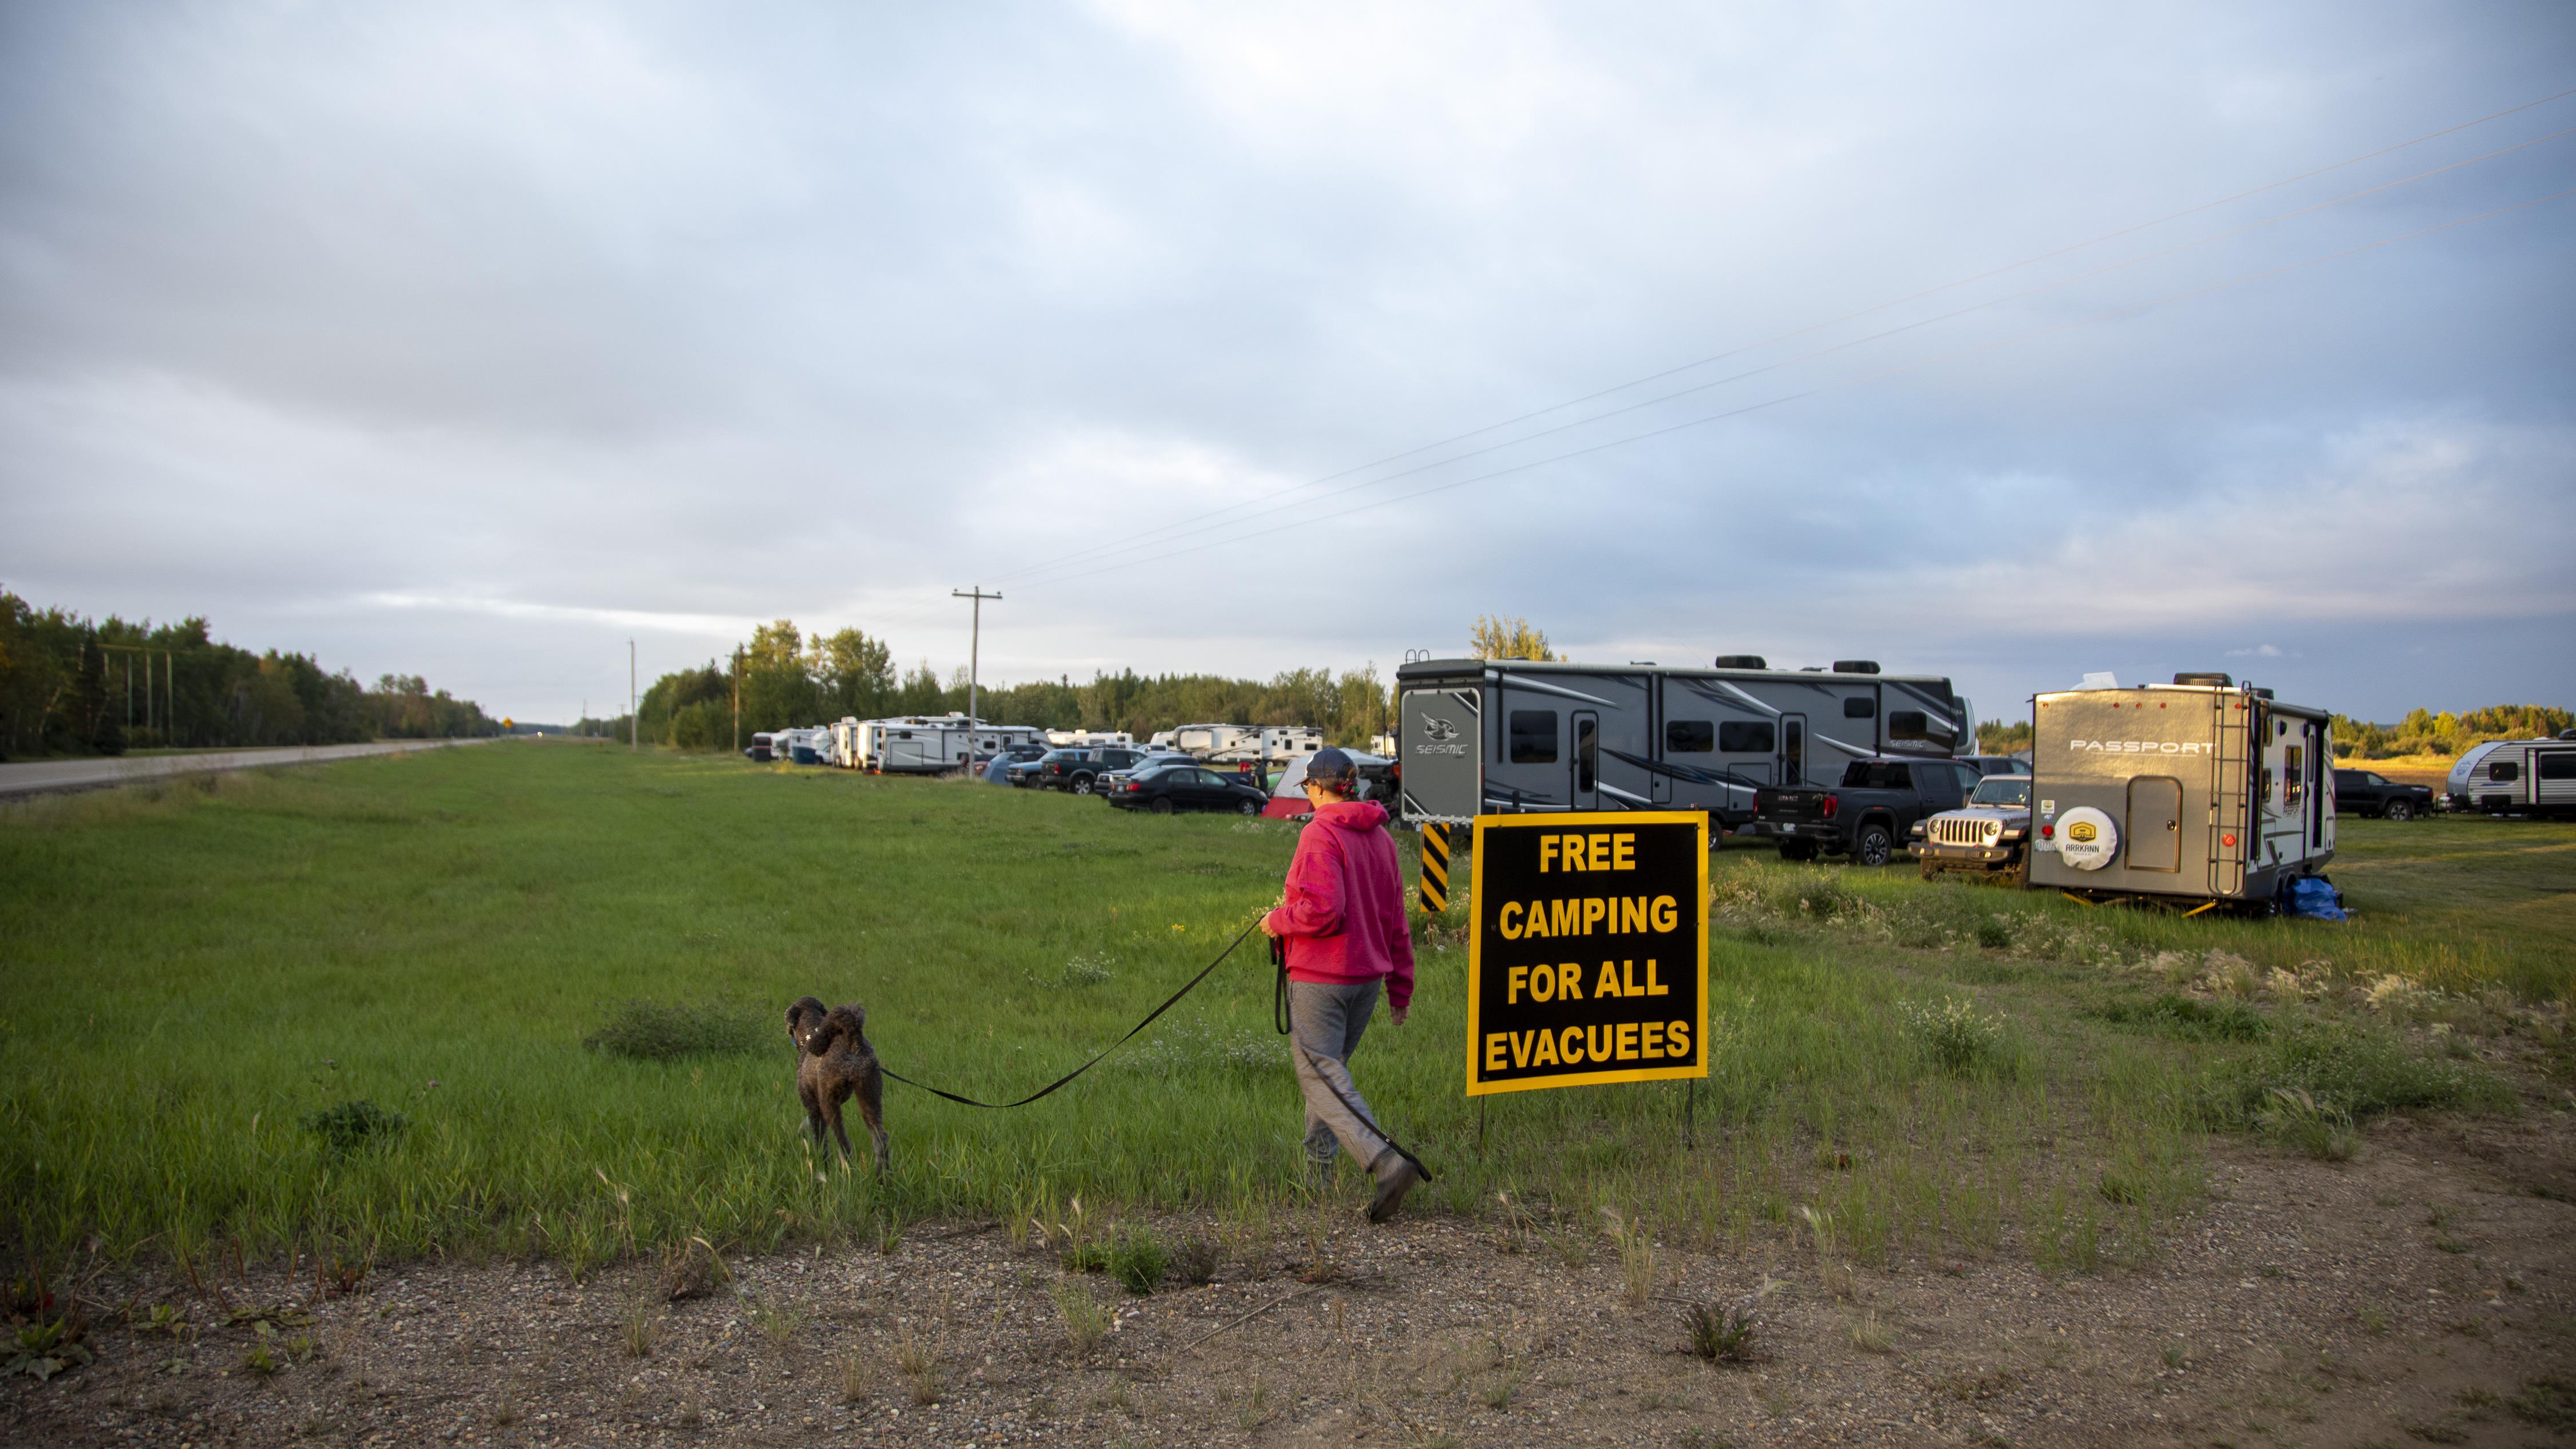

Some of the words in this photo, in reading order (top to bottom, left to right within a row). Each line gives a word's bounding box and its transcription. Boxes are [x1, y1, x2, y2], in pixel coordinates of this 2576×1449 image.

[1415, 744, 1468, 754] SEISMIC
[1890, 740, 1926, 748] SEISMIC
[2071, 740, 2215, 754] PASSPORT
[1540, 834, 1635, 872] FREE
[2066, 844, 2099, 852] ARRKANN
[1500, 895, 1677, 939] CAMPING
[1509, 964, 1583, 1004] FOR
[1594, 960, 1668, 998] ALL
[1486, 1021, 1690, 1071] EVACUEES
